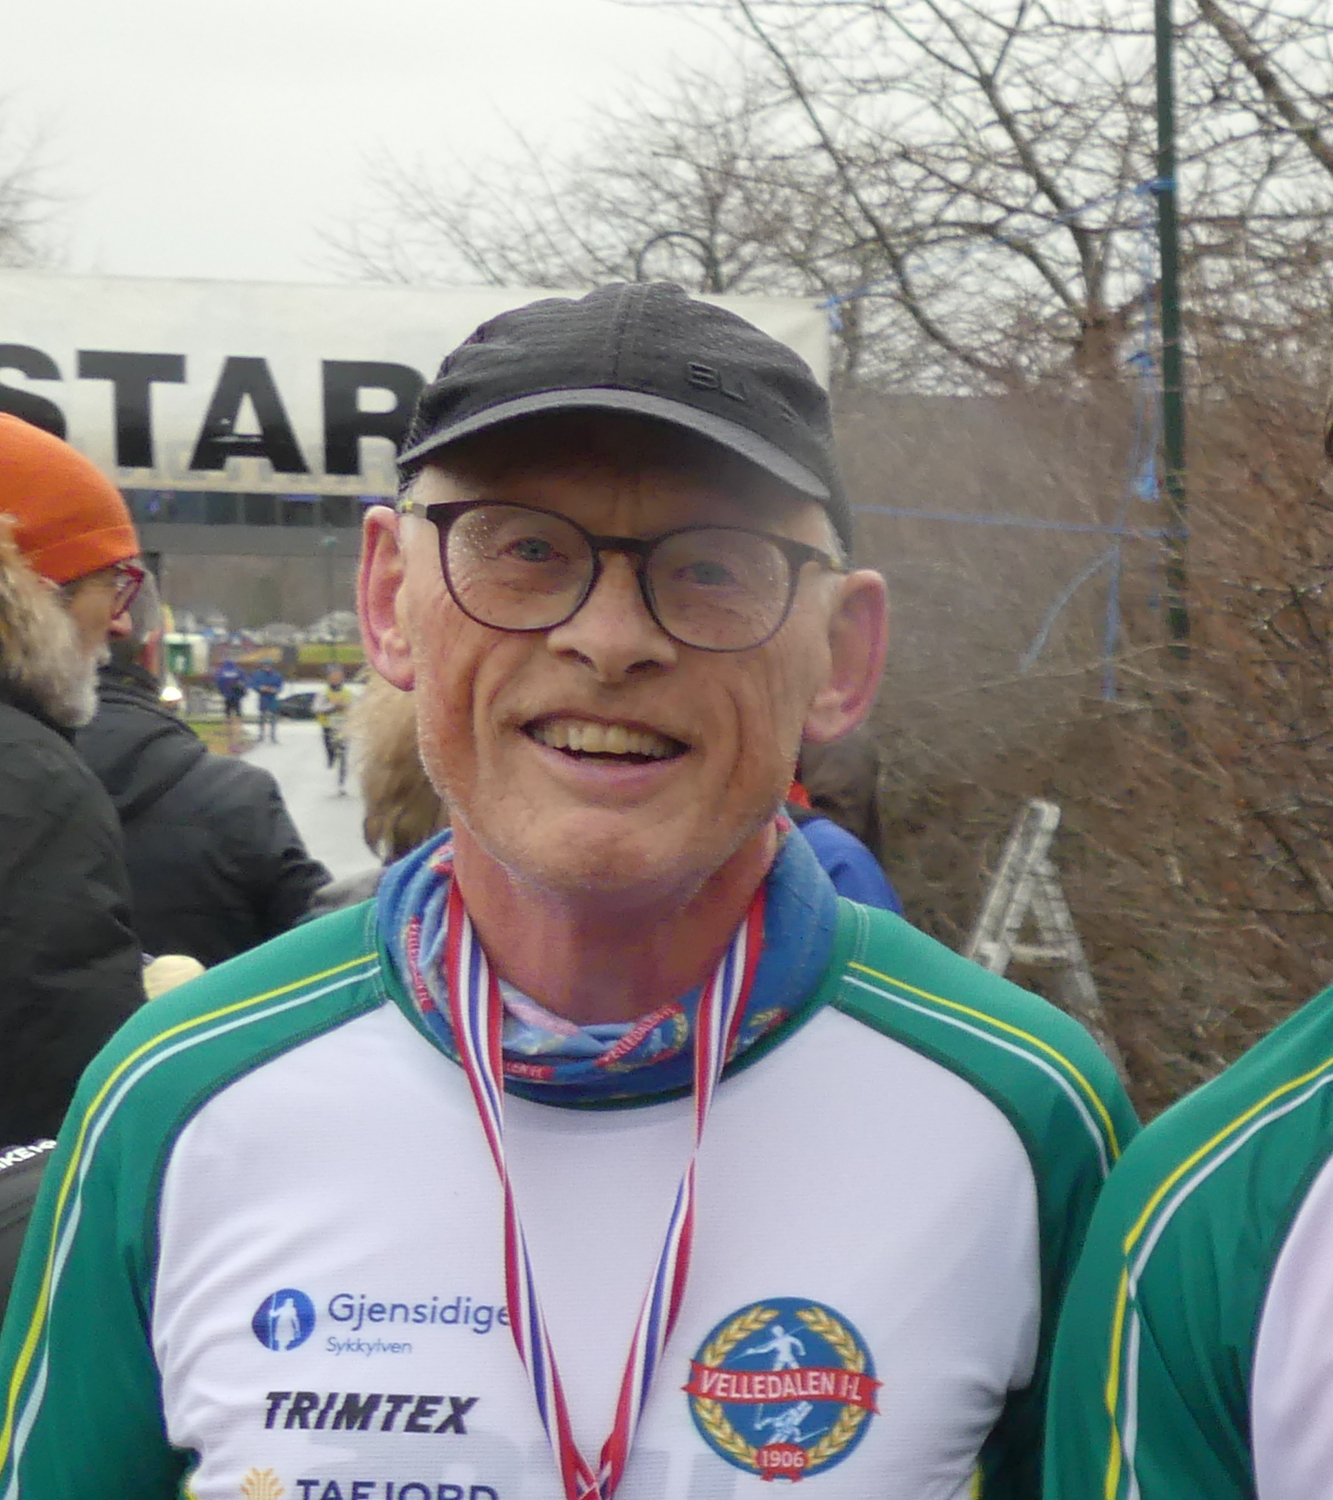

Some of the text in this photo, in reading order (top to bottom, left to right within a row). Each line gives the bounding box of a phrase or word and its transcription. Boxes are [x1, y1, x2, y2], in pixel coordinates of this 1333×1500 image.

[0, 343, 428, 477] STAR
[326, 1337, 412, 1357] Sykkylven
[700, 1367, 837, 1399] VELLEDALEN
[264, 1391, 479, 1434] TRIMTEX
[760, 1450, 804, 1469] 1906
